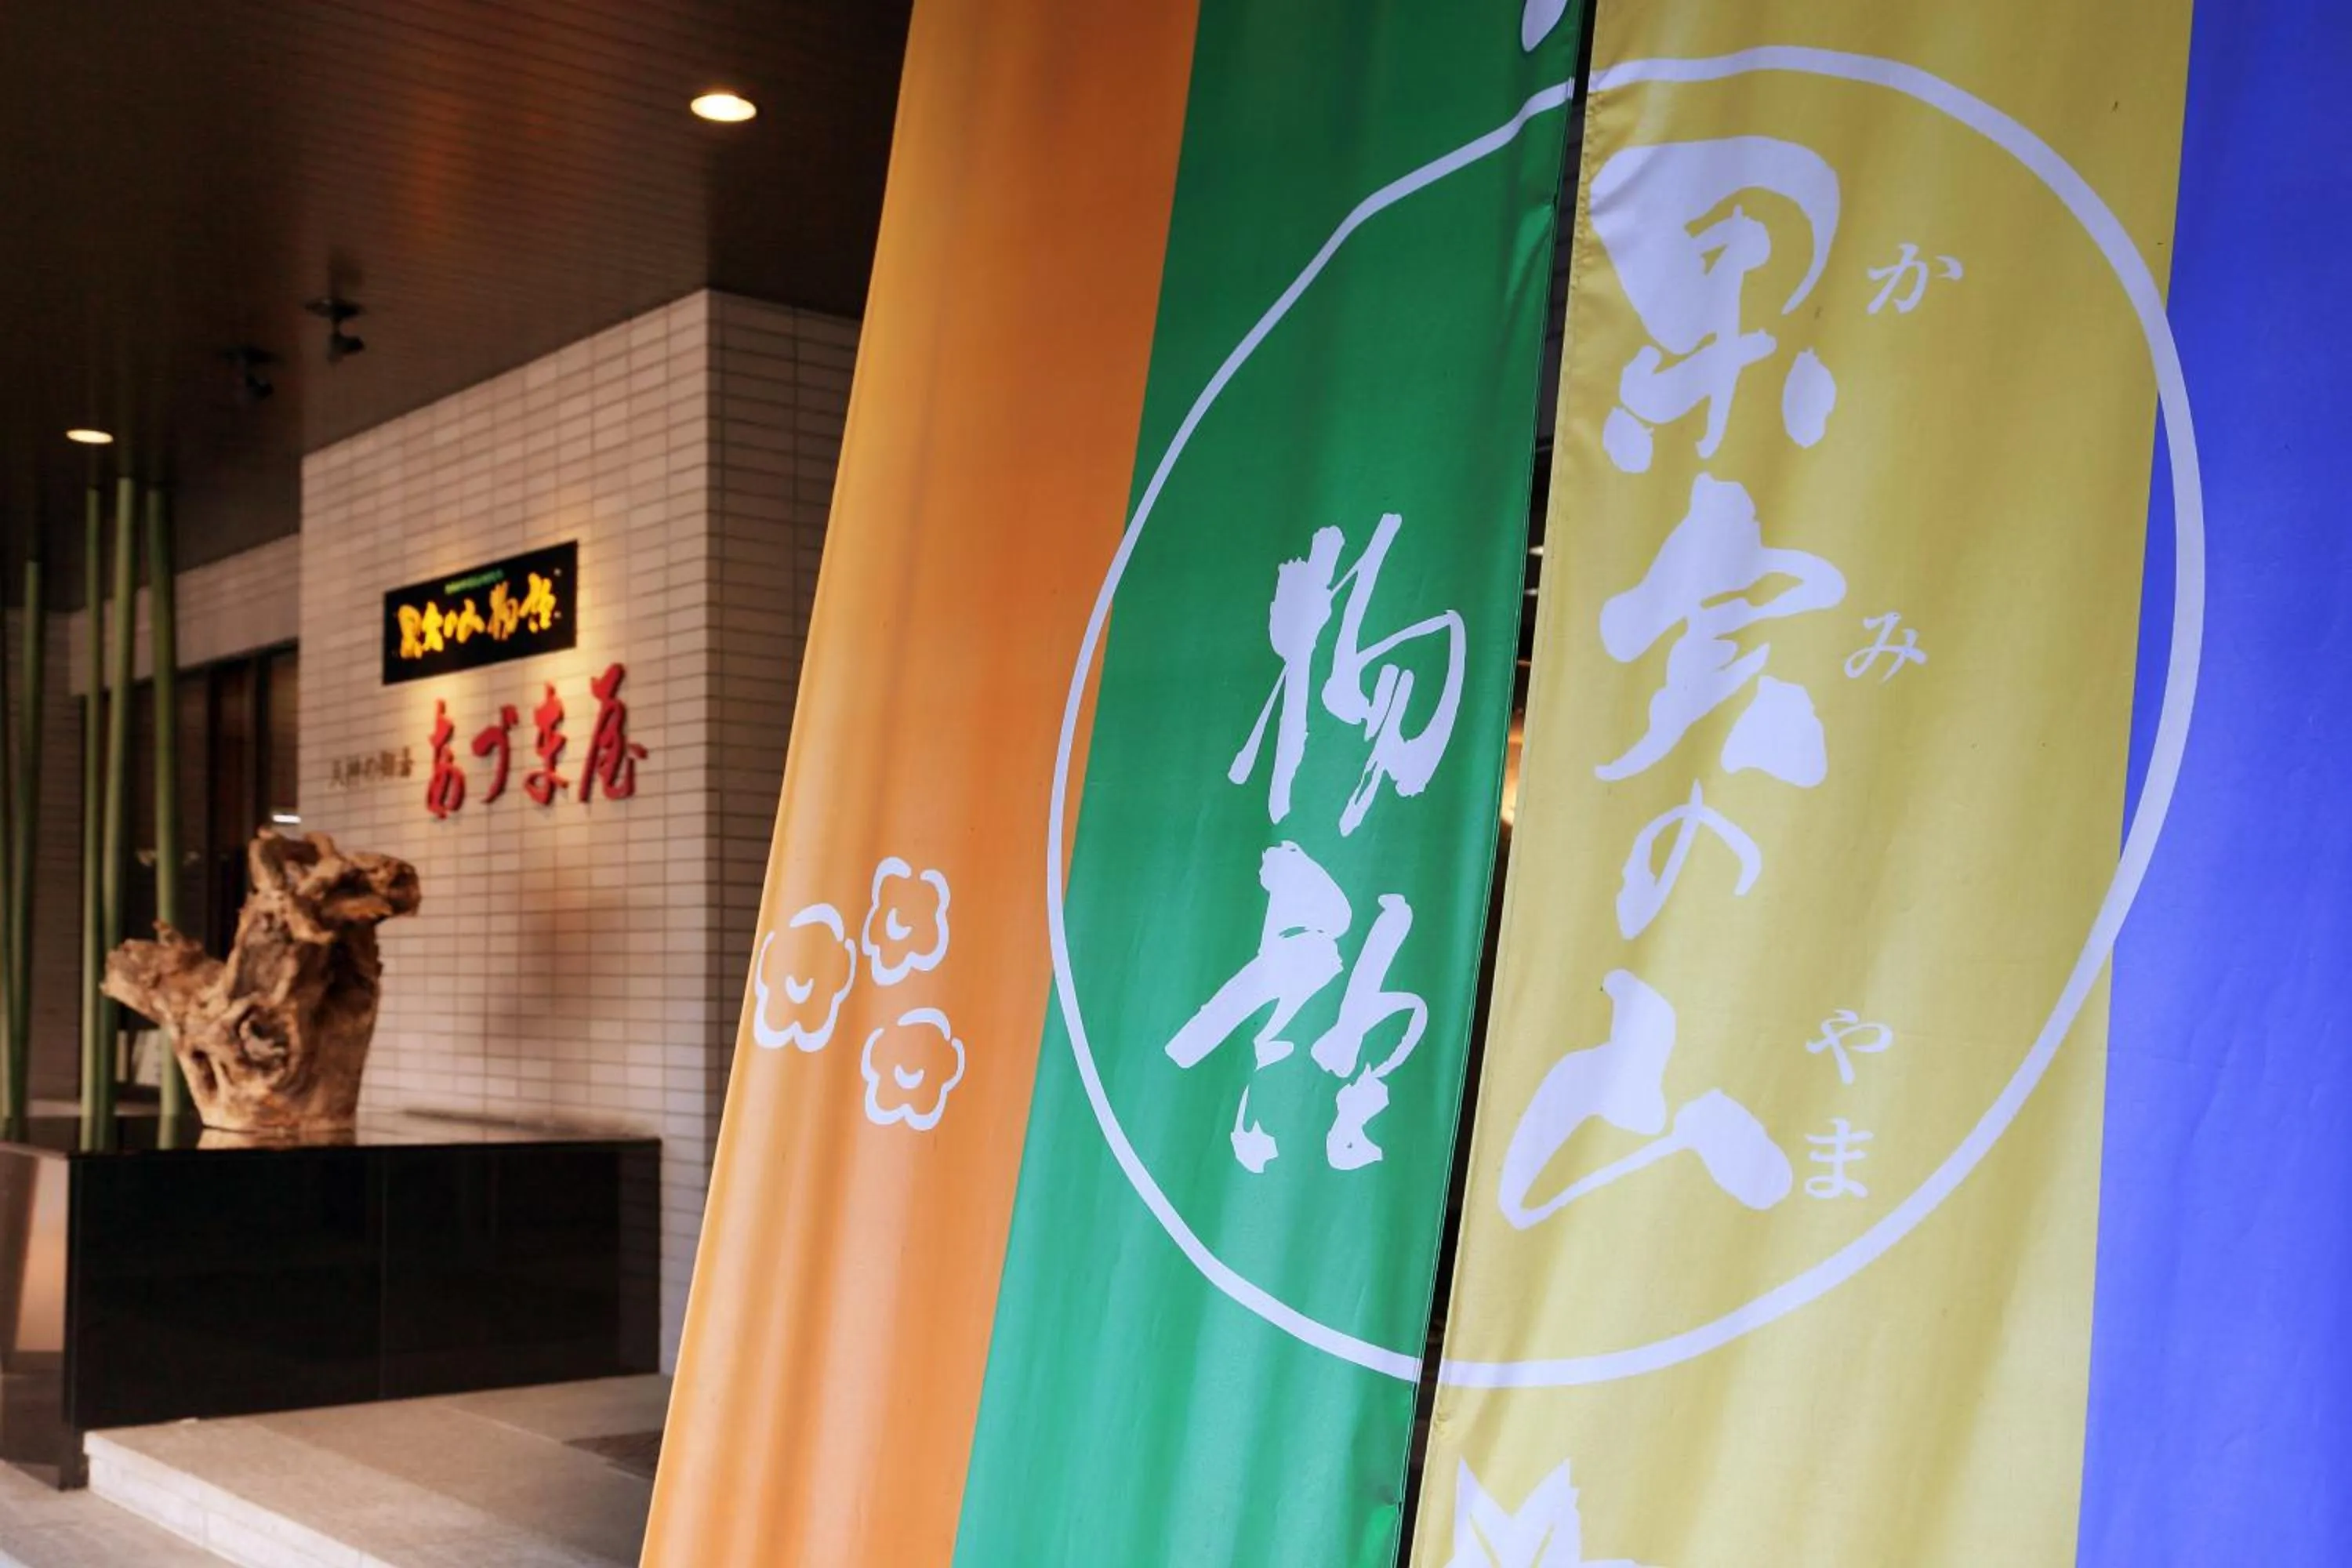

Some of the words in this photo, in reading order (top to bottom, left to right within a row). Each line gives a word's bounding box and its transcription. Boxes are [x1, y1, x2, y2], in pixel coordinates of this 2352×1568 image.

[1866, 242, 1963, 314] か
[1498, 136, 1846, 1230] 果実の山
[1843, 612, 1926, 682] み
[426, 662, 648, 819] あづま屋
[1805, 1009, 1893, 1200] やま
